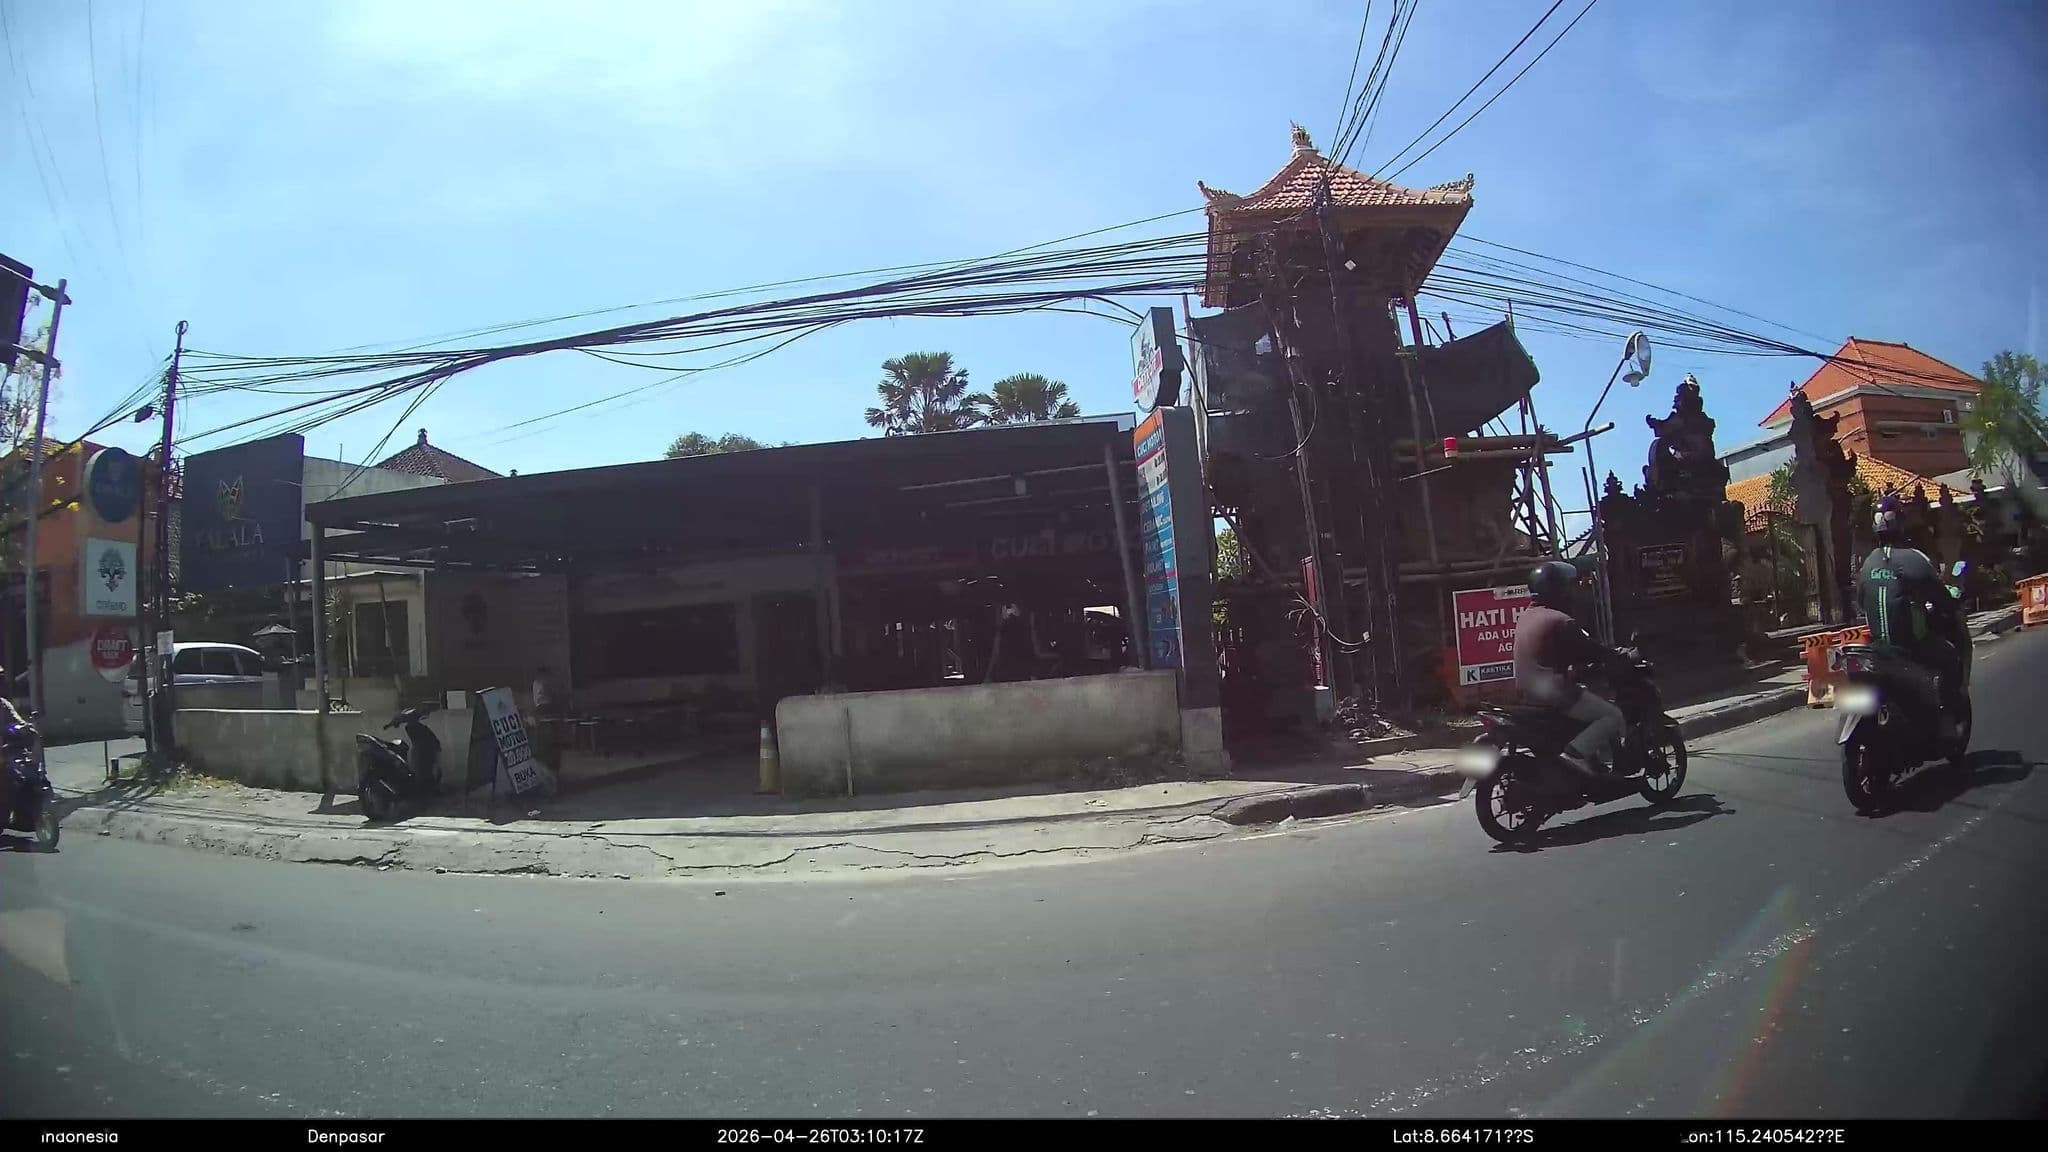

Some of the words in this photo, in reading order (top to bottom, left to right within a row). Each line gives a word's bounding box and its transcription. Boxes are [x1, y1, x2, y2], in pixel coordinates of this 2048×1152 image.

[1460, 608, 1506, 629] HATI
[1512, 606, 1526, 624] H
[1477, 630, 1499, 642] ADA
[1502, 628, 1516, 639] UP
[1498, 642, 1513, 653] AG
[493, 713, 521, 736] CUCI
